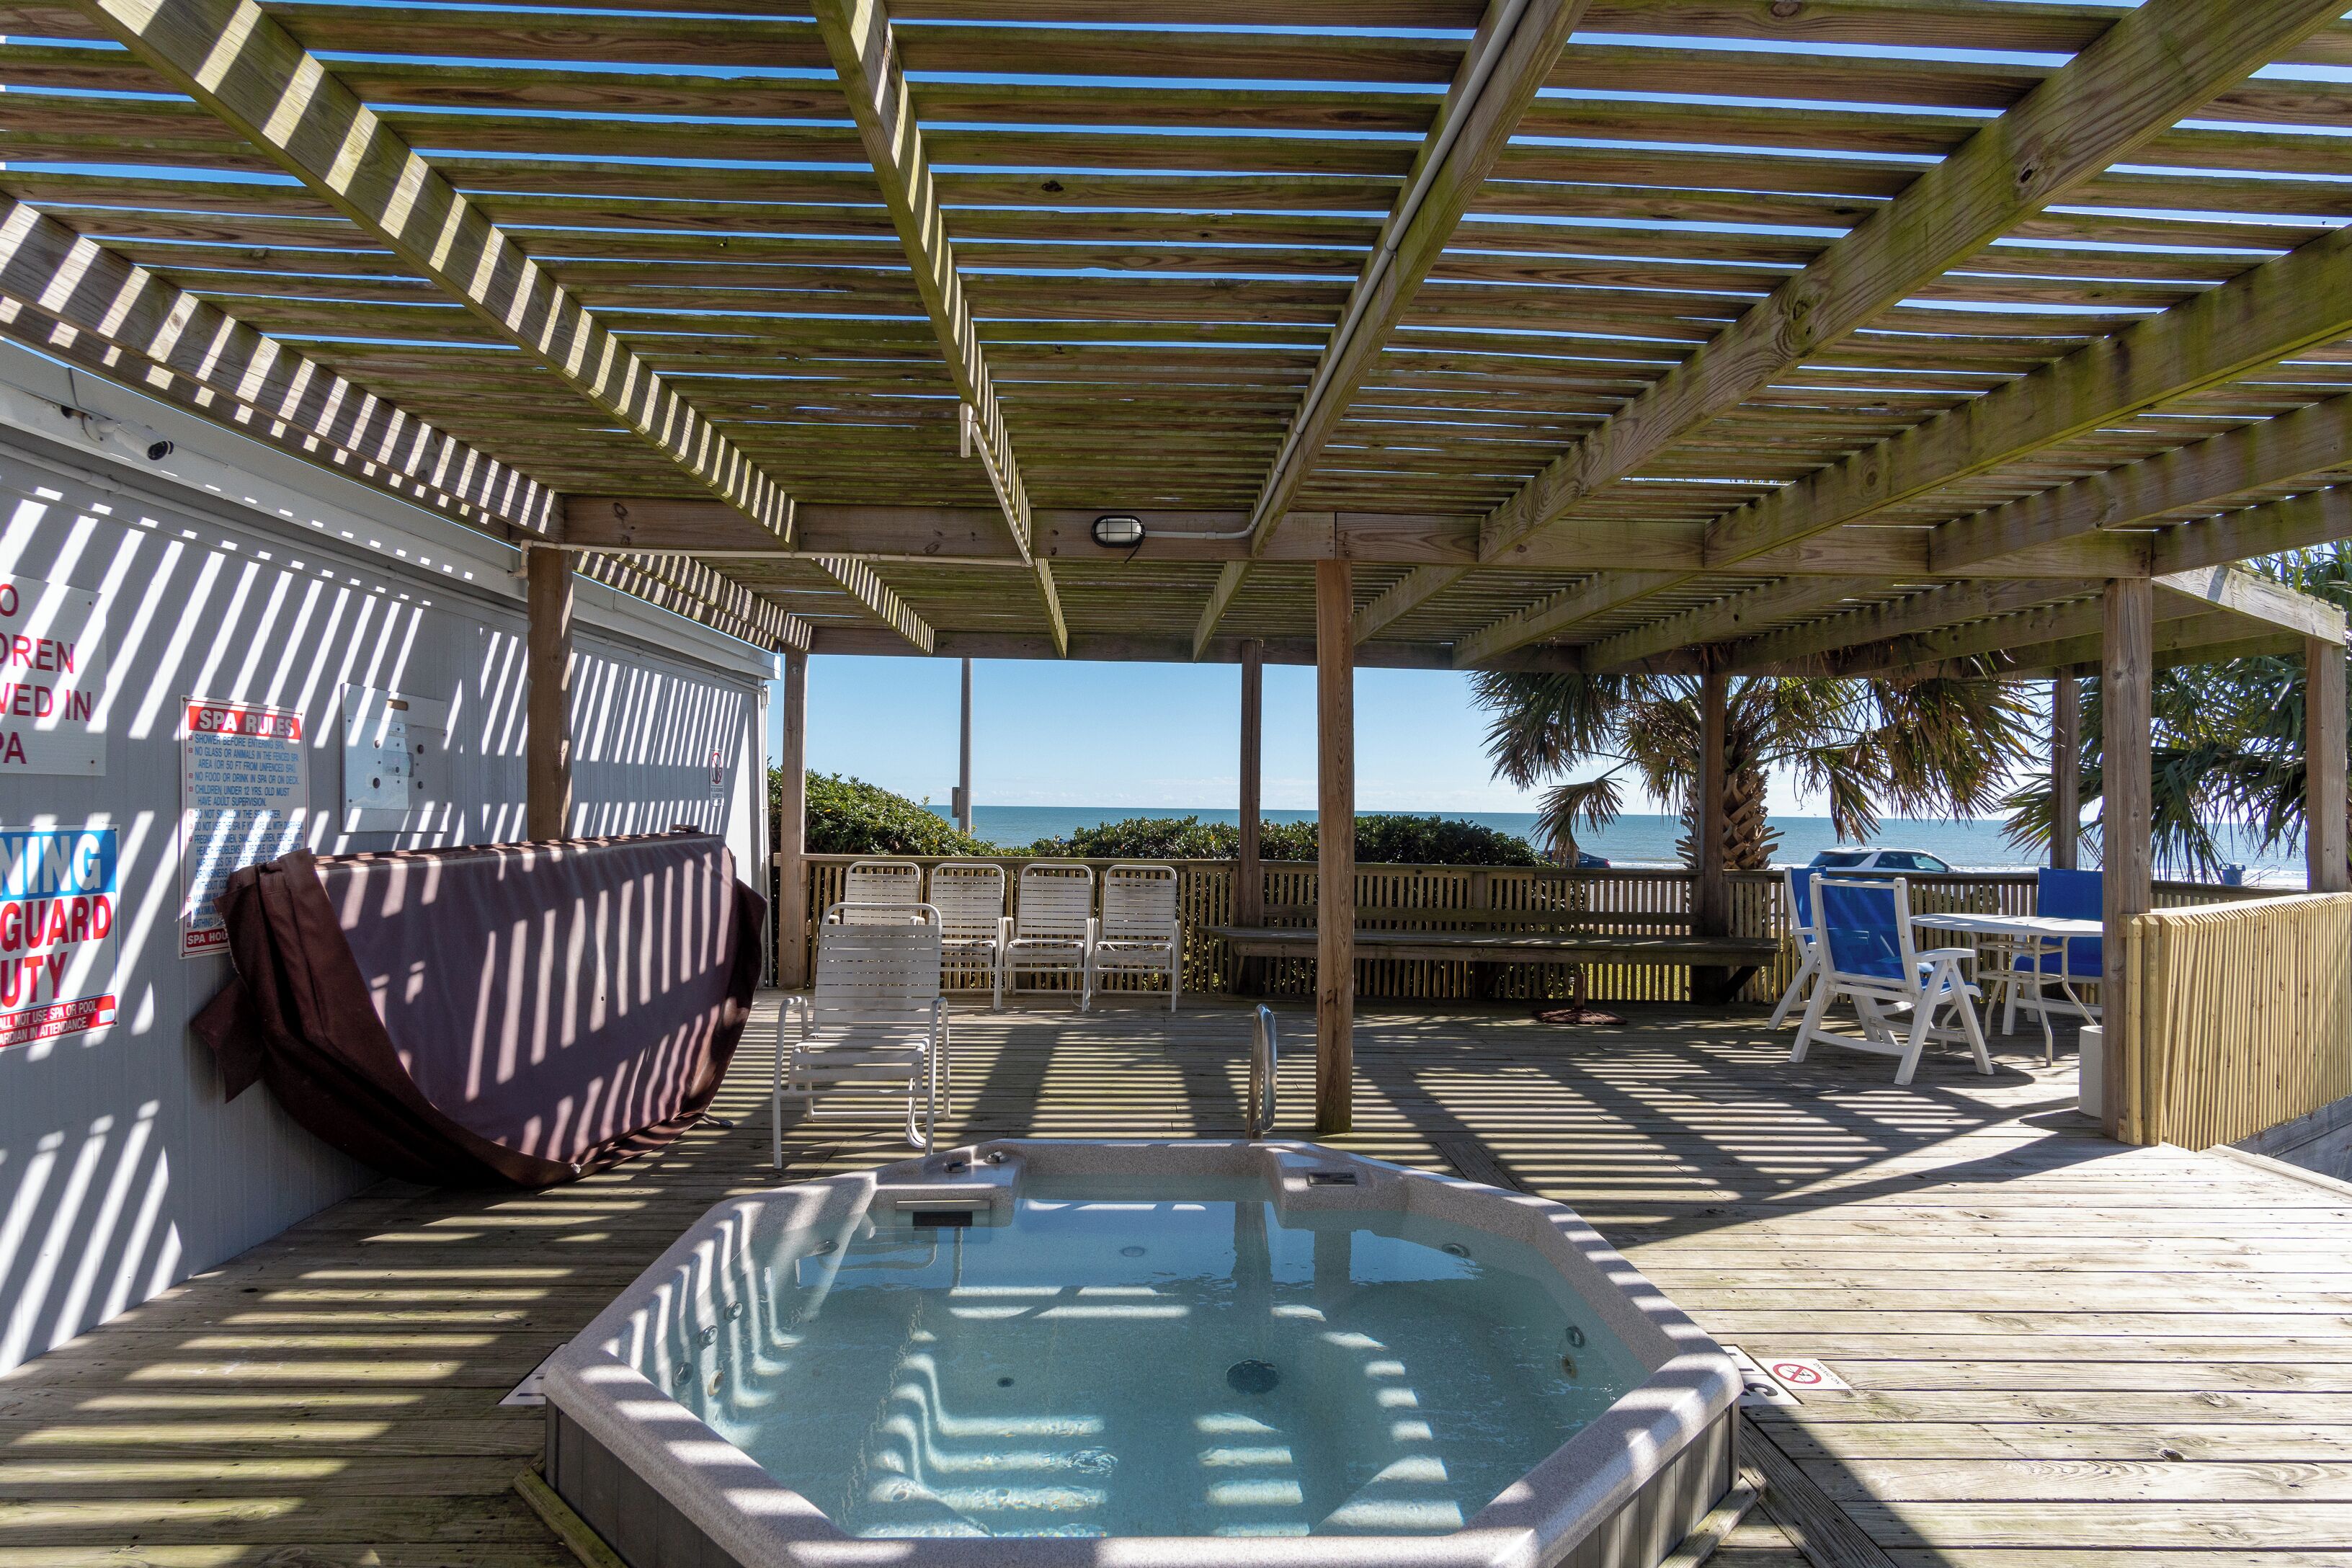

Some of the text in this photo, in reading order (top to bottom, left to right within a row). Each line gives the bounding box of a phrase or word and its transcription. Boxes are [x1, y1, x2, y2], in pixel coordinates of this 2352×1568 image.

[65, 690, 91, 721] IN
[200, 709, 294, 736] SPA RULES
[195, 734, 220, 744] SHOWER
[223, 736, 246, 747] BEFORE
[248, 739, 273, 749] ENTERING
[195, 746, 202, 756] NO
[205, 747, 222, 757] GLASS
[224, 748, 231, 757] OR
[233, 749, 254, 759] ANIMALS
[198, 759, 212, 768] AREA
[226, 760, 233, 770] 50
[235, 760, 242, 770] FT
[244, 762, 257, 771] FROM
[259, 762, 284, 772] UNFENCED
[195, 772, 203, 781] NO
[205, 772, 220, 781] FOOD
[223, 772, 231, 782] OR
[233, 773, 248, 783] DRINK
[251, 774, 255, 783] IN
[257, 775, 267, 783] SPA
[269, 775, 275, 784] OR
[277, 775, 285, 784] ON
[224, 785, 242, 795] UNDER
[244, 786, 249, 795] 12
[264, 787, 275, 796] OLD
[276, 788, 290, 796] MUST
[198, 796, 211, 806] HAVE
[214, 796, 230, 806] ADULT
[205, 809, 215, 819] NOT
[243, 809, 252, 819] THE
[0, 833, 101, 895] NING
[0, 895, 111, 952] GUARD
[187, 934, 205, 945] SPA
[14, 1012, 30, 1026] NOT
[32, 1009, 48, 1023] USE
[50, 1006, 64, 1020] SPA
[66, 1003, 76, 1016] OR
[79, 999, 97, 1012] POOL
[30, 1026, 37, 1038] IN
